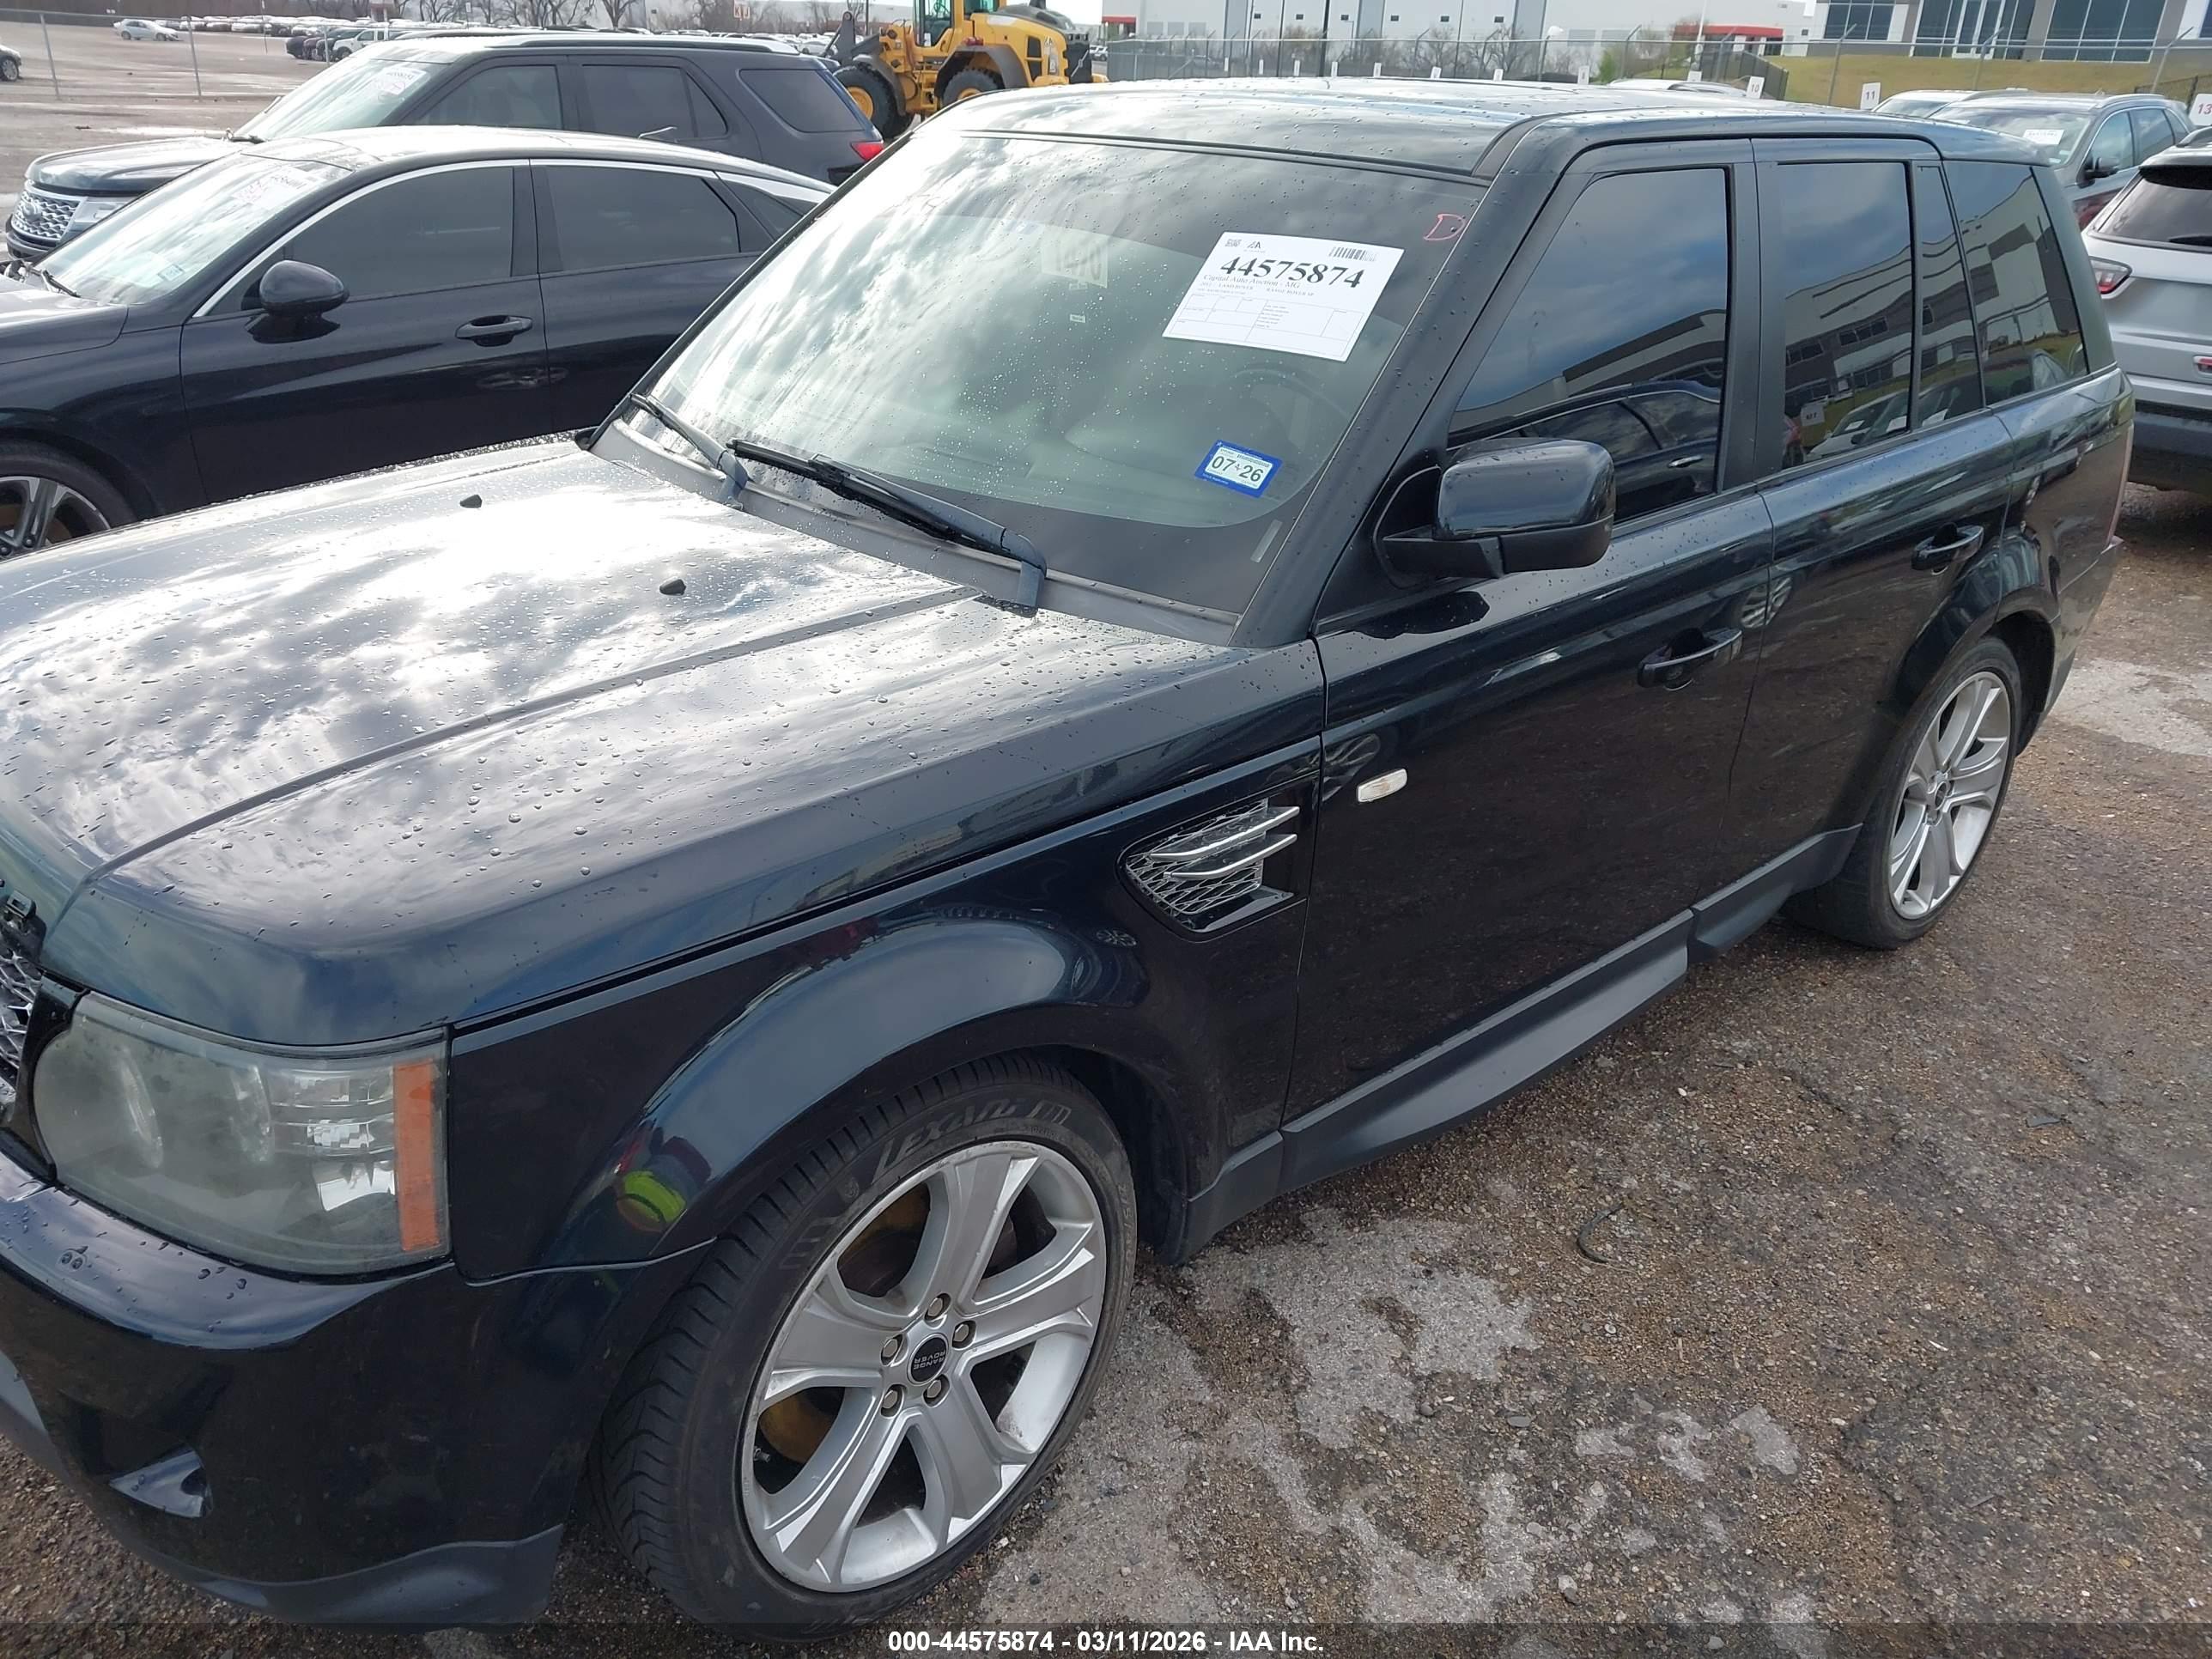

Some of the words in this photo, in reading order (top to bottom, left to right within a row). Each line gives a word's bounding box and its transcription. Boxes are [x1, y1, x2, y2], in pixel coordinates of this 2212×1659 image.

[1865, 90, 1875, 100] 11
[1220, 256, 1366, 289] 44575874
[1203, 274, 1230, 283] Capital
[1249, 277, 1279, 287] Auction
[1212, 456, 1237, 472] 07
[1238, 465, 1264, 483] 26
[913, 1357, 945, 1370] RANGE
[914, 1350, 946, 1364] ROVER
